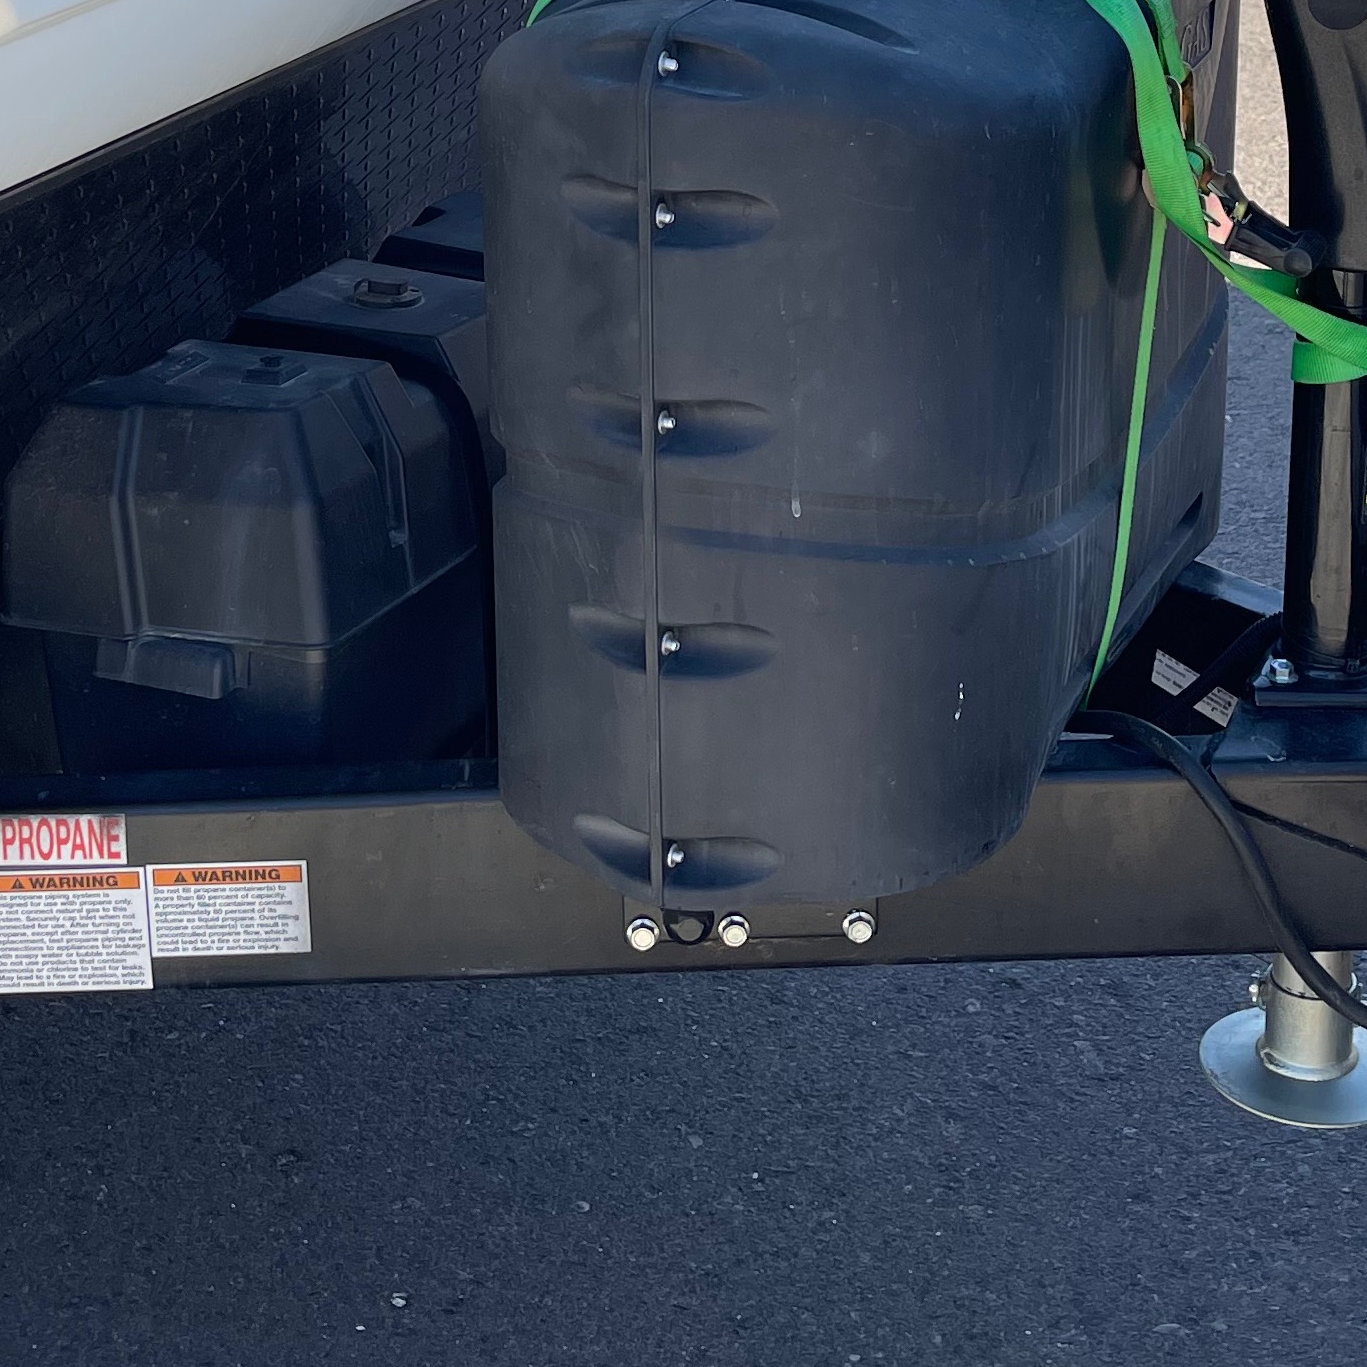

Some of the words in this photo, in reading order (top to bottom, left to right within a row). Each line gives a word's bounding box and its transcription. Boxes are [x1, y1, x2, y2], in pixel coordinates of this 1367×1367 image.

[1, 818, 122, 861] PROPANE
[29, 875, 119, 889] WARNING
[191, 868, 281, 883] WARNING
